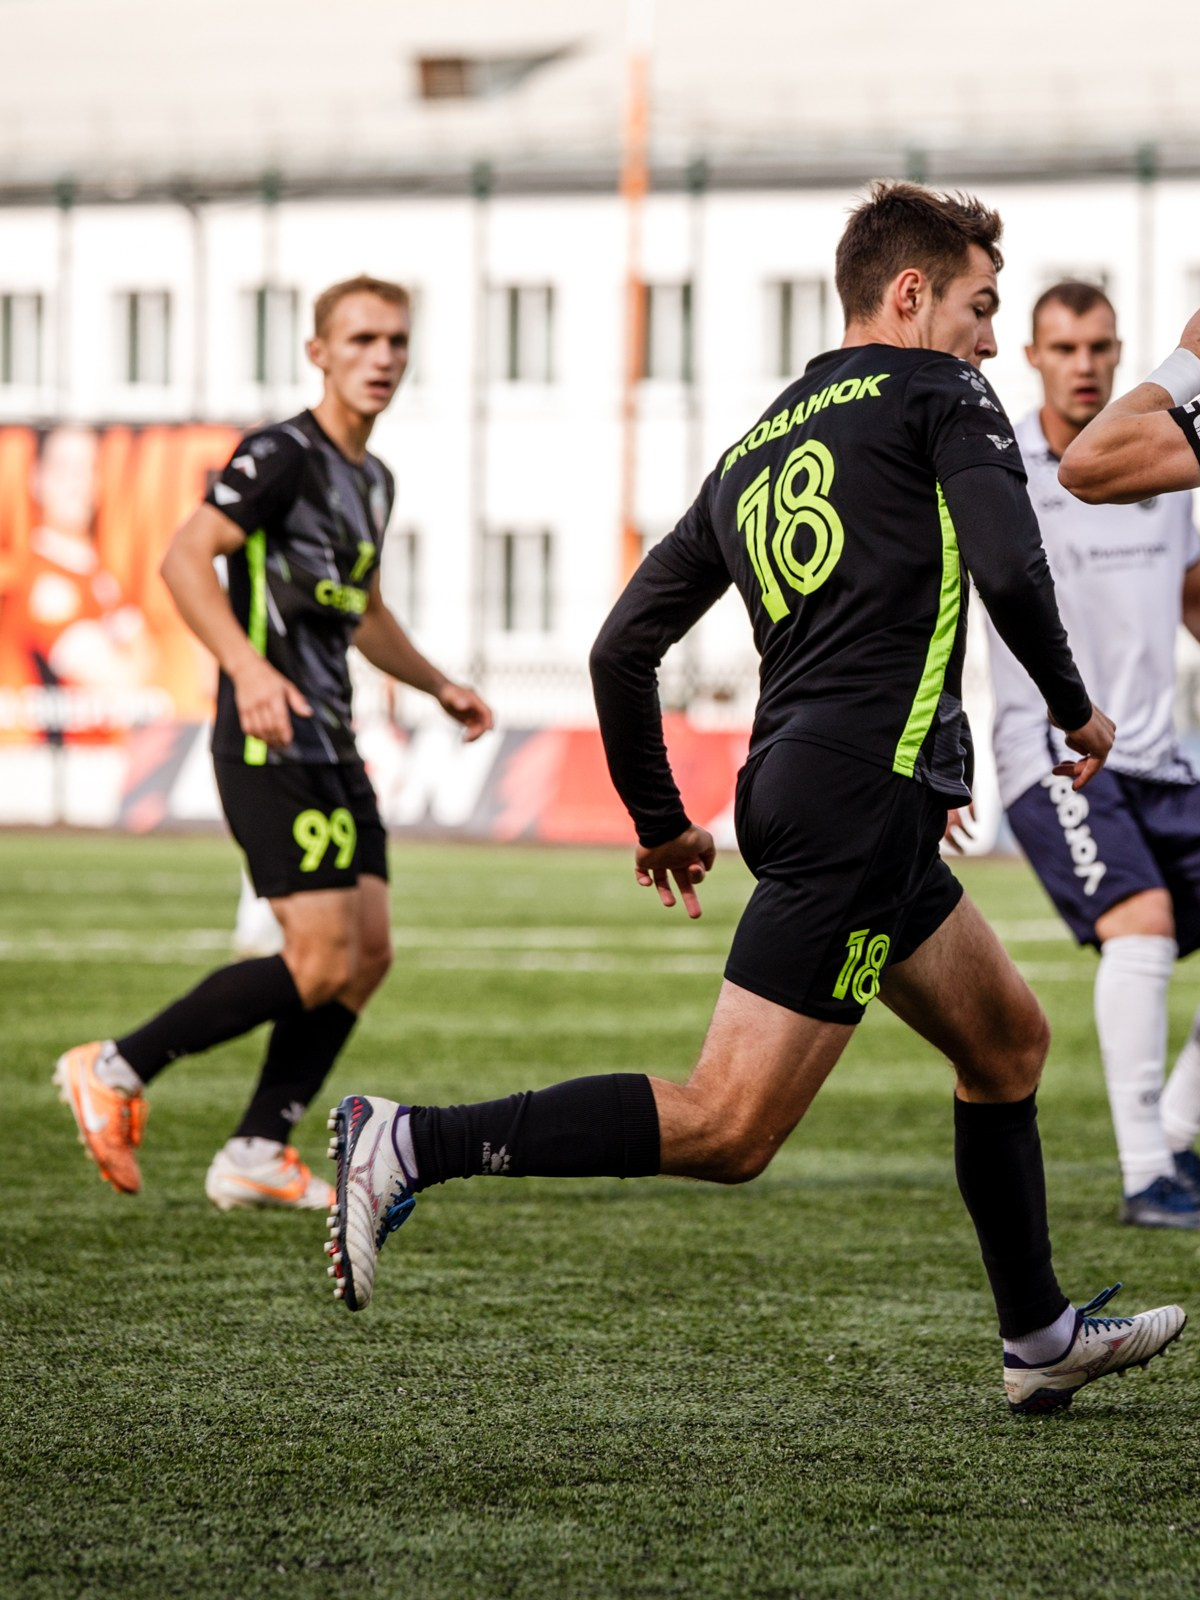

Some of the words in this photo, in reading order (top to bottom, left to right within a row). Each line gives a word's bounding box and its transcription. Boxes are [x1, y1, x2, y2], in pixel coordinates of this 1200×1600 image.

[736, 438, 845, 624] 18
[292, 807, 357, 873] 99
[832, 928, 891, 1006] 18
